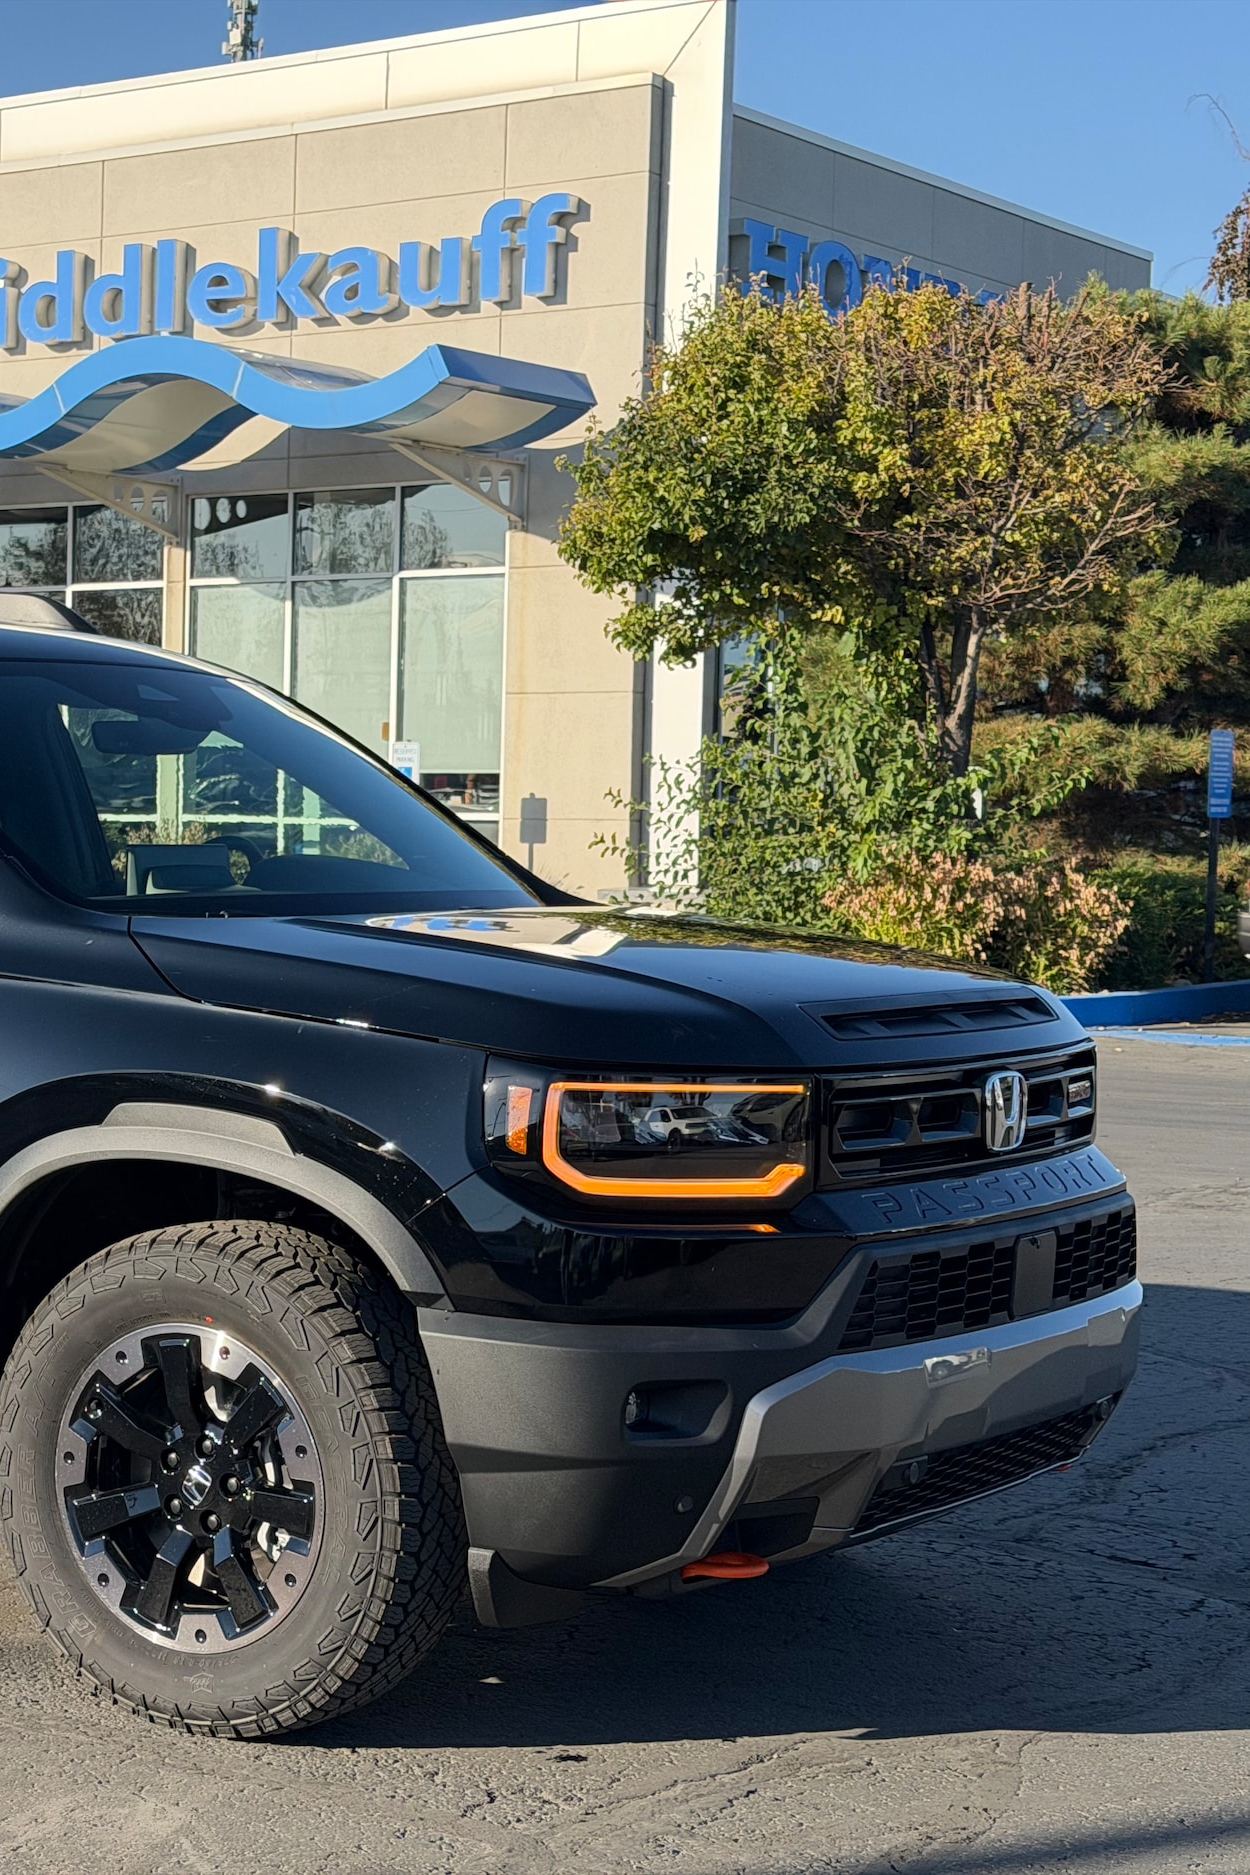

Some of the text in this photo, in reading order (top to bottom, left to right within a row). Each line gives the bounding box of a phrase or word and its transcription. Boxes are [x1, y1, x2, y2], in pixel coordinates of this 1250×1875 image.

[740, 218, 1003, 318] HON
[861, 1153, 1106, 1224] PASSPORT
[16, 1442, 98, 1638] GRABBER
